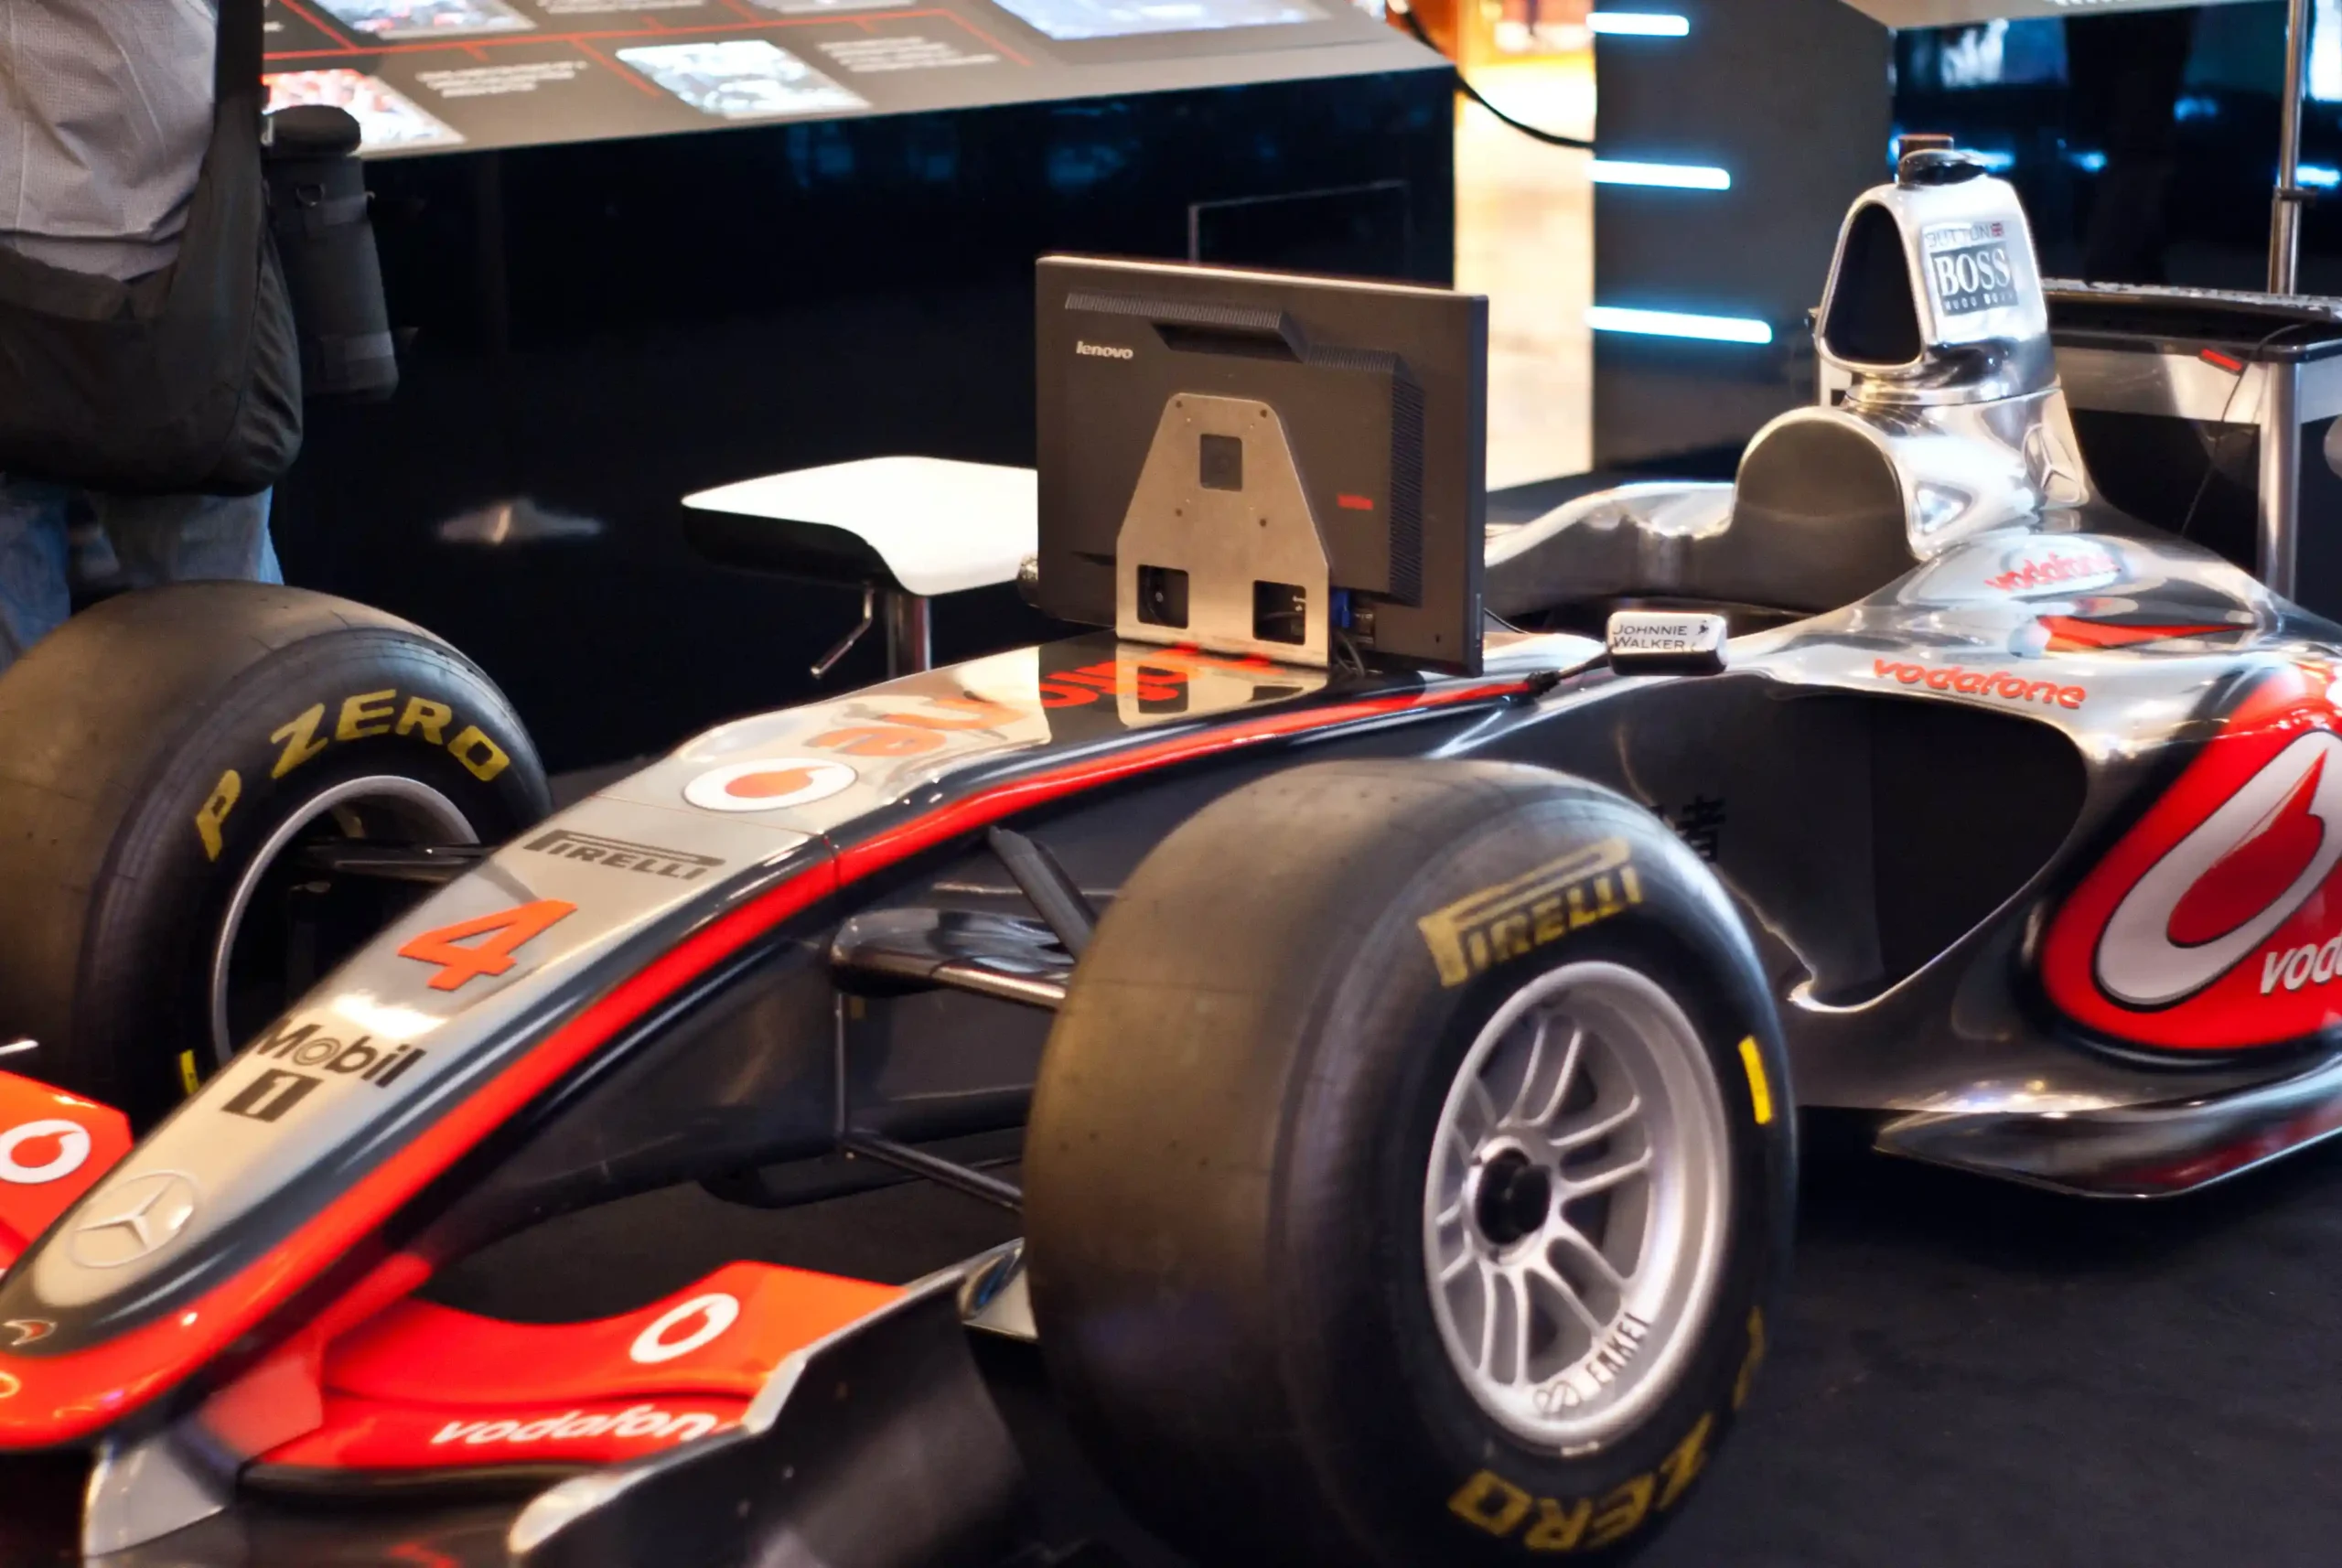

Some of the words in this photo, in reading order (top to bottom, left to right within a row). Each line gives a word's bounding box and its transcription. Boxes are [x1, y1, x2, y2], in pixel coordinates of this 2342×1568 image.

[1933, 247, 2012, 296] BOSS
[1076, 340, 1133, 360] lenovo
[1612, 624, 1688, 637] JOHNNIE
[1613, 636, 1685, 650] WALKER
[1874, 658, 2087, 710] vodafone
[195, 768, 242, 862] P
[270, 688, 510, 782] ZERO
[522, 829, 726, 881] PIRELLI
[1418, 836, 1643, 988] PIRELLI
[397, 898, 578, 992] 4
[2260, 928, 2342, 996] vod
[256, 1017, 427, 1089] Mobil
[430, 1402, 736, 1444] vodafon
[1447, 1411, 1716, 1551] ZERO
